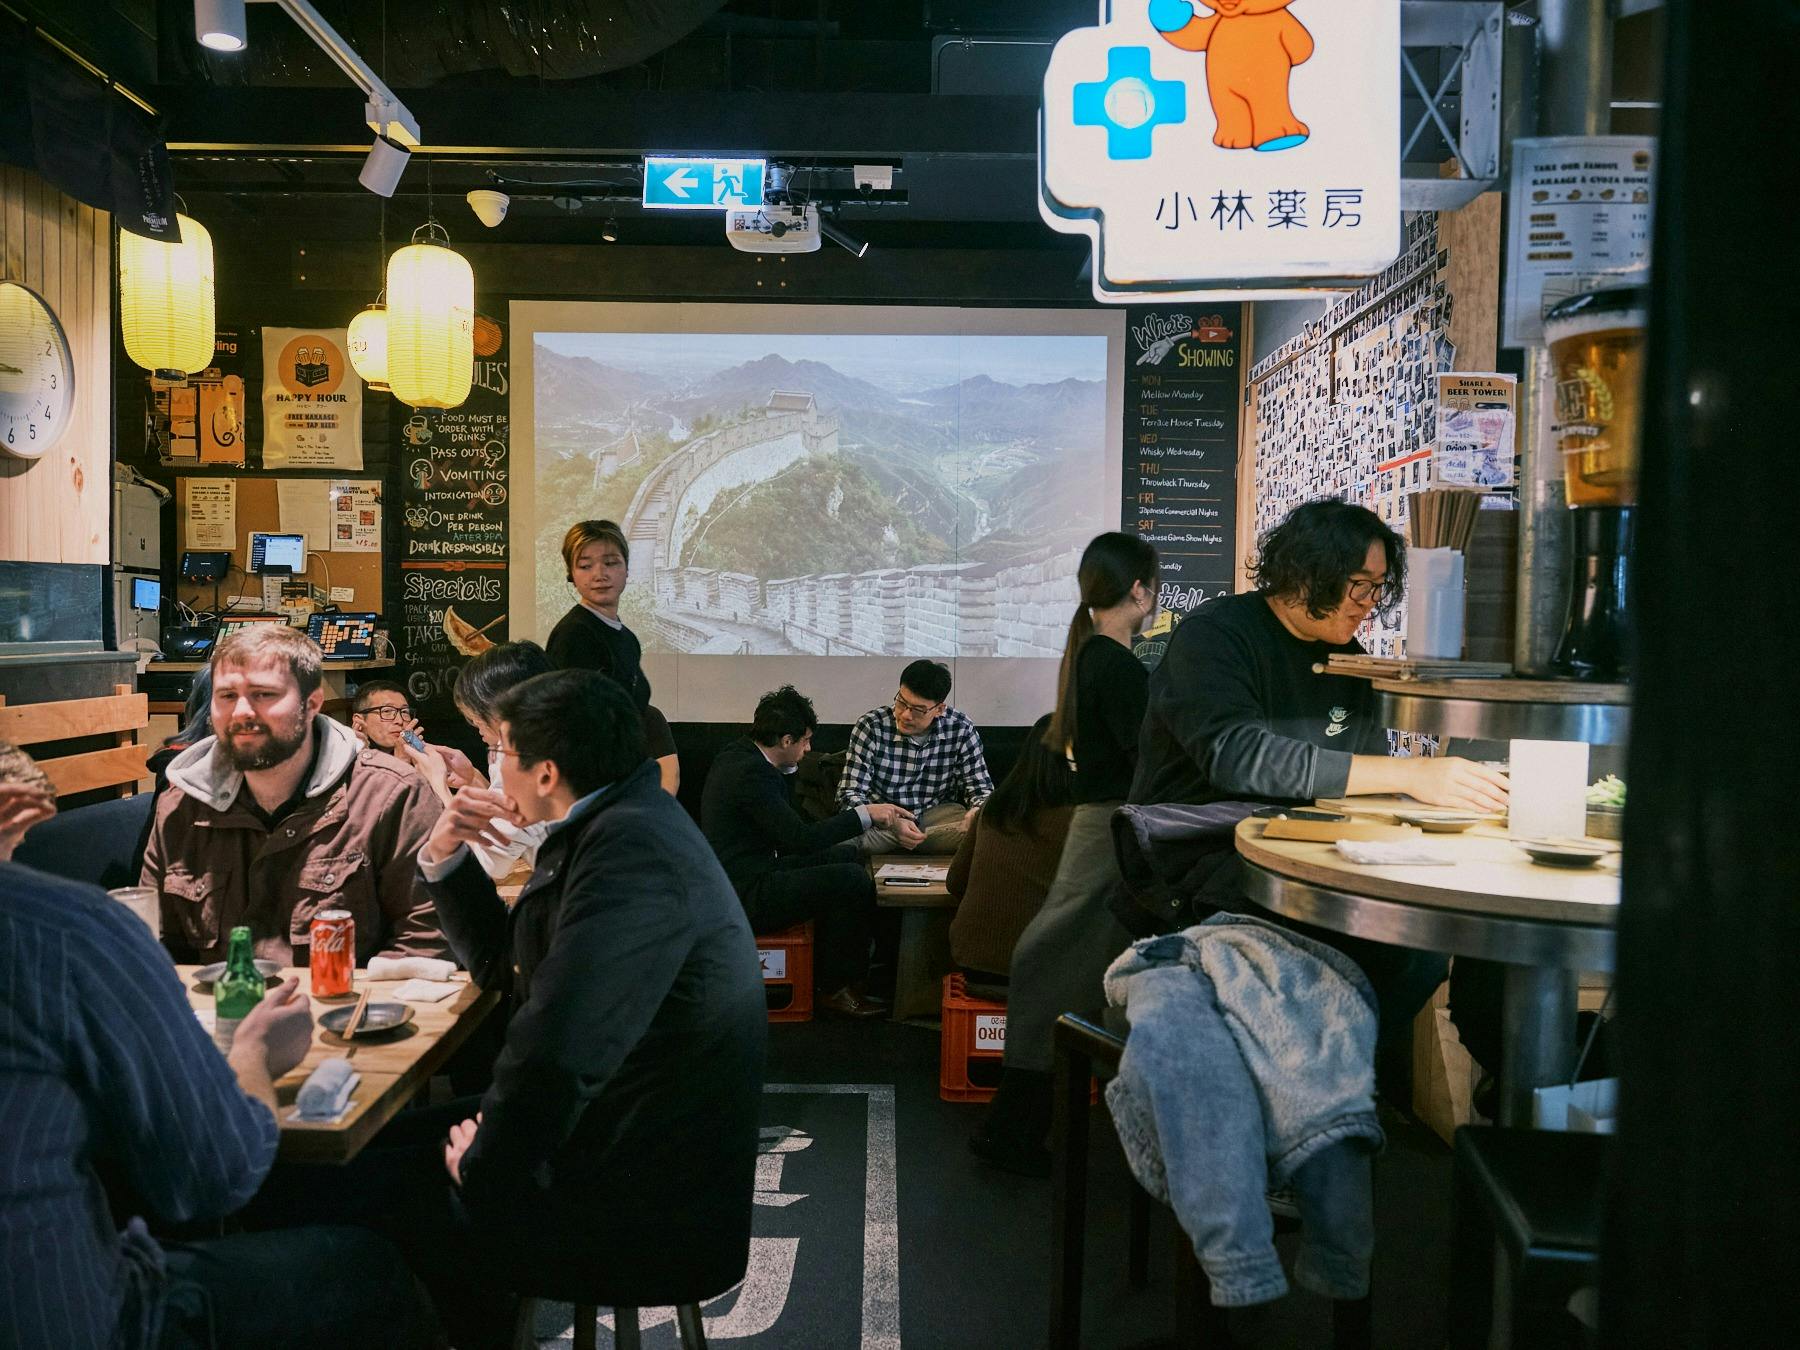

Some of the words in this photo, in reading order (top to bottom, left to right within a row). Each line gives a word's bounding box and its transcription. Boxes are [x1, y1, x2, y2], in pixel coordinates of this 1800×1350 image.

[1156, 189, 1363, 230] 小林薬房
[142, 214, 168, 226] PREMIUM
[1131, 312, 1193, 351] What's
[45, 341, 52, 357] 2
[215, 340, 237, 353] ling
[1178, 343, 1234, 367] SHOWING
[50, 374, 57, 390] 3
[472, 361, 508, 395] ULES
[1141, 390, 1170, 399] Mellow
[1171, 390, 1204, 401] Monday
[1447, 388, 1469, 396] BEER
[1472, 388, 1507, 396] TOWER!
[276, 394, 311, 402] HAPPY
[316, 394, 347, 403] HOUR
[44, 405, 51, 420] 4
[1140, 404, 1158, 415] TUE
[441, 413, 465, 423] FOOD
[468, 414, 493, 423] MUST
[496, 414, 508, 423] BE
[1170, 418, 1194, 427] House
[1194, 419, 1225, 429] Tuesday
[29, 424, 36, 440] 5
[438, 424, 468, 433] ORDER
[471, 424, 494, 433] WITH
[7, 427, 15, 444] 6
[451, 432, 486, 442] DRINKS
[1140, 434, 1158, 444] WED
[430, 446, 457, 460] PASS
[460, 447, 486, 458] OUTS
[1166, 447, 1205, 459] Wednesday
[440, 468, 508, 482] VOMITING
[1139, 463, 1160, 475] THU
[1139, 477, 1177, 488] Throwback
[1178, 478, 1211, 489] Thursday
[424, 490, 484, 501] INTOXICATION
[1138, 492, 1155, 504] FRI
[1198, 507, 1219, 517] Nights
[429, 510, 454, 527] ONE
[457, 511, 484, 521] DRINK
[1138, 519, 1155, 530] SAT
[447, 521, 464, 533] PER
[468, 521, 503, 532] PERSON
[453, 532, 481, 541] AFTER
[484, 532, 503, 541] 9PM
[1185, 533, 1203, 543] Show
[1202, 534, 1223, 545] Nights
[410, 539, 440, 555] DRINK
[442, 540, 506, 557] RESPONSIBLY
[1159, 561, 1183, 571] Sunday
[403, 572, 501, 601] Specials
[1158, 582, 1212, 612] Hell
[429, 609, 444, 624] $20
[403, 624, 443, 649] TAKE
